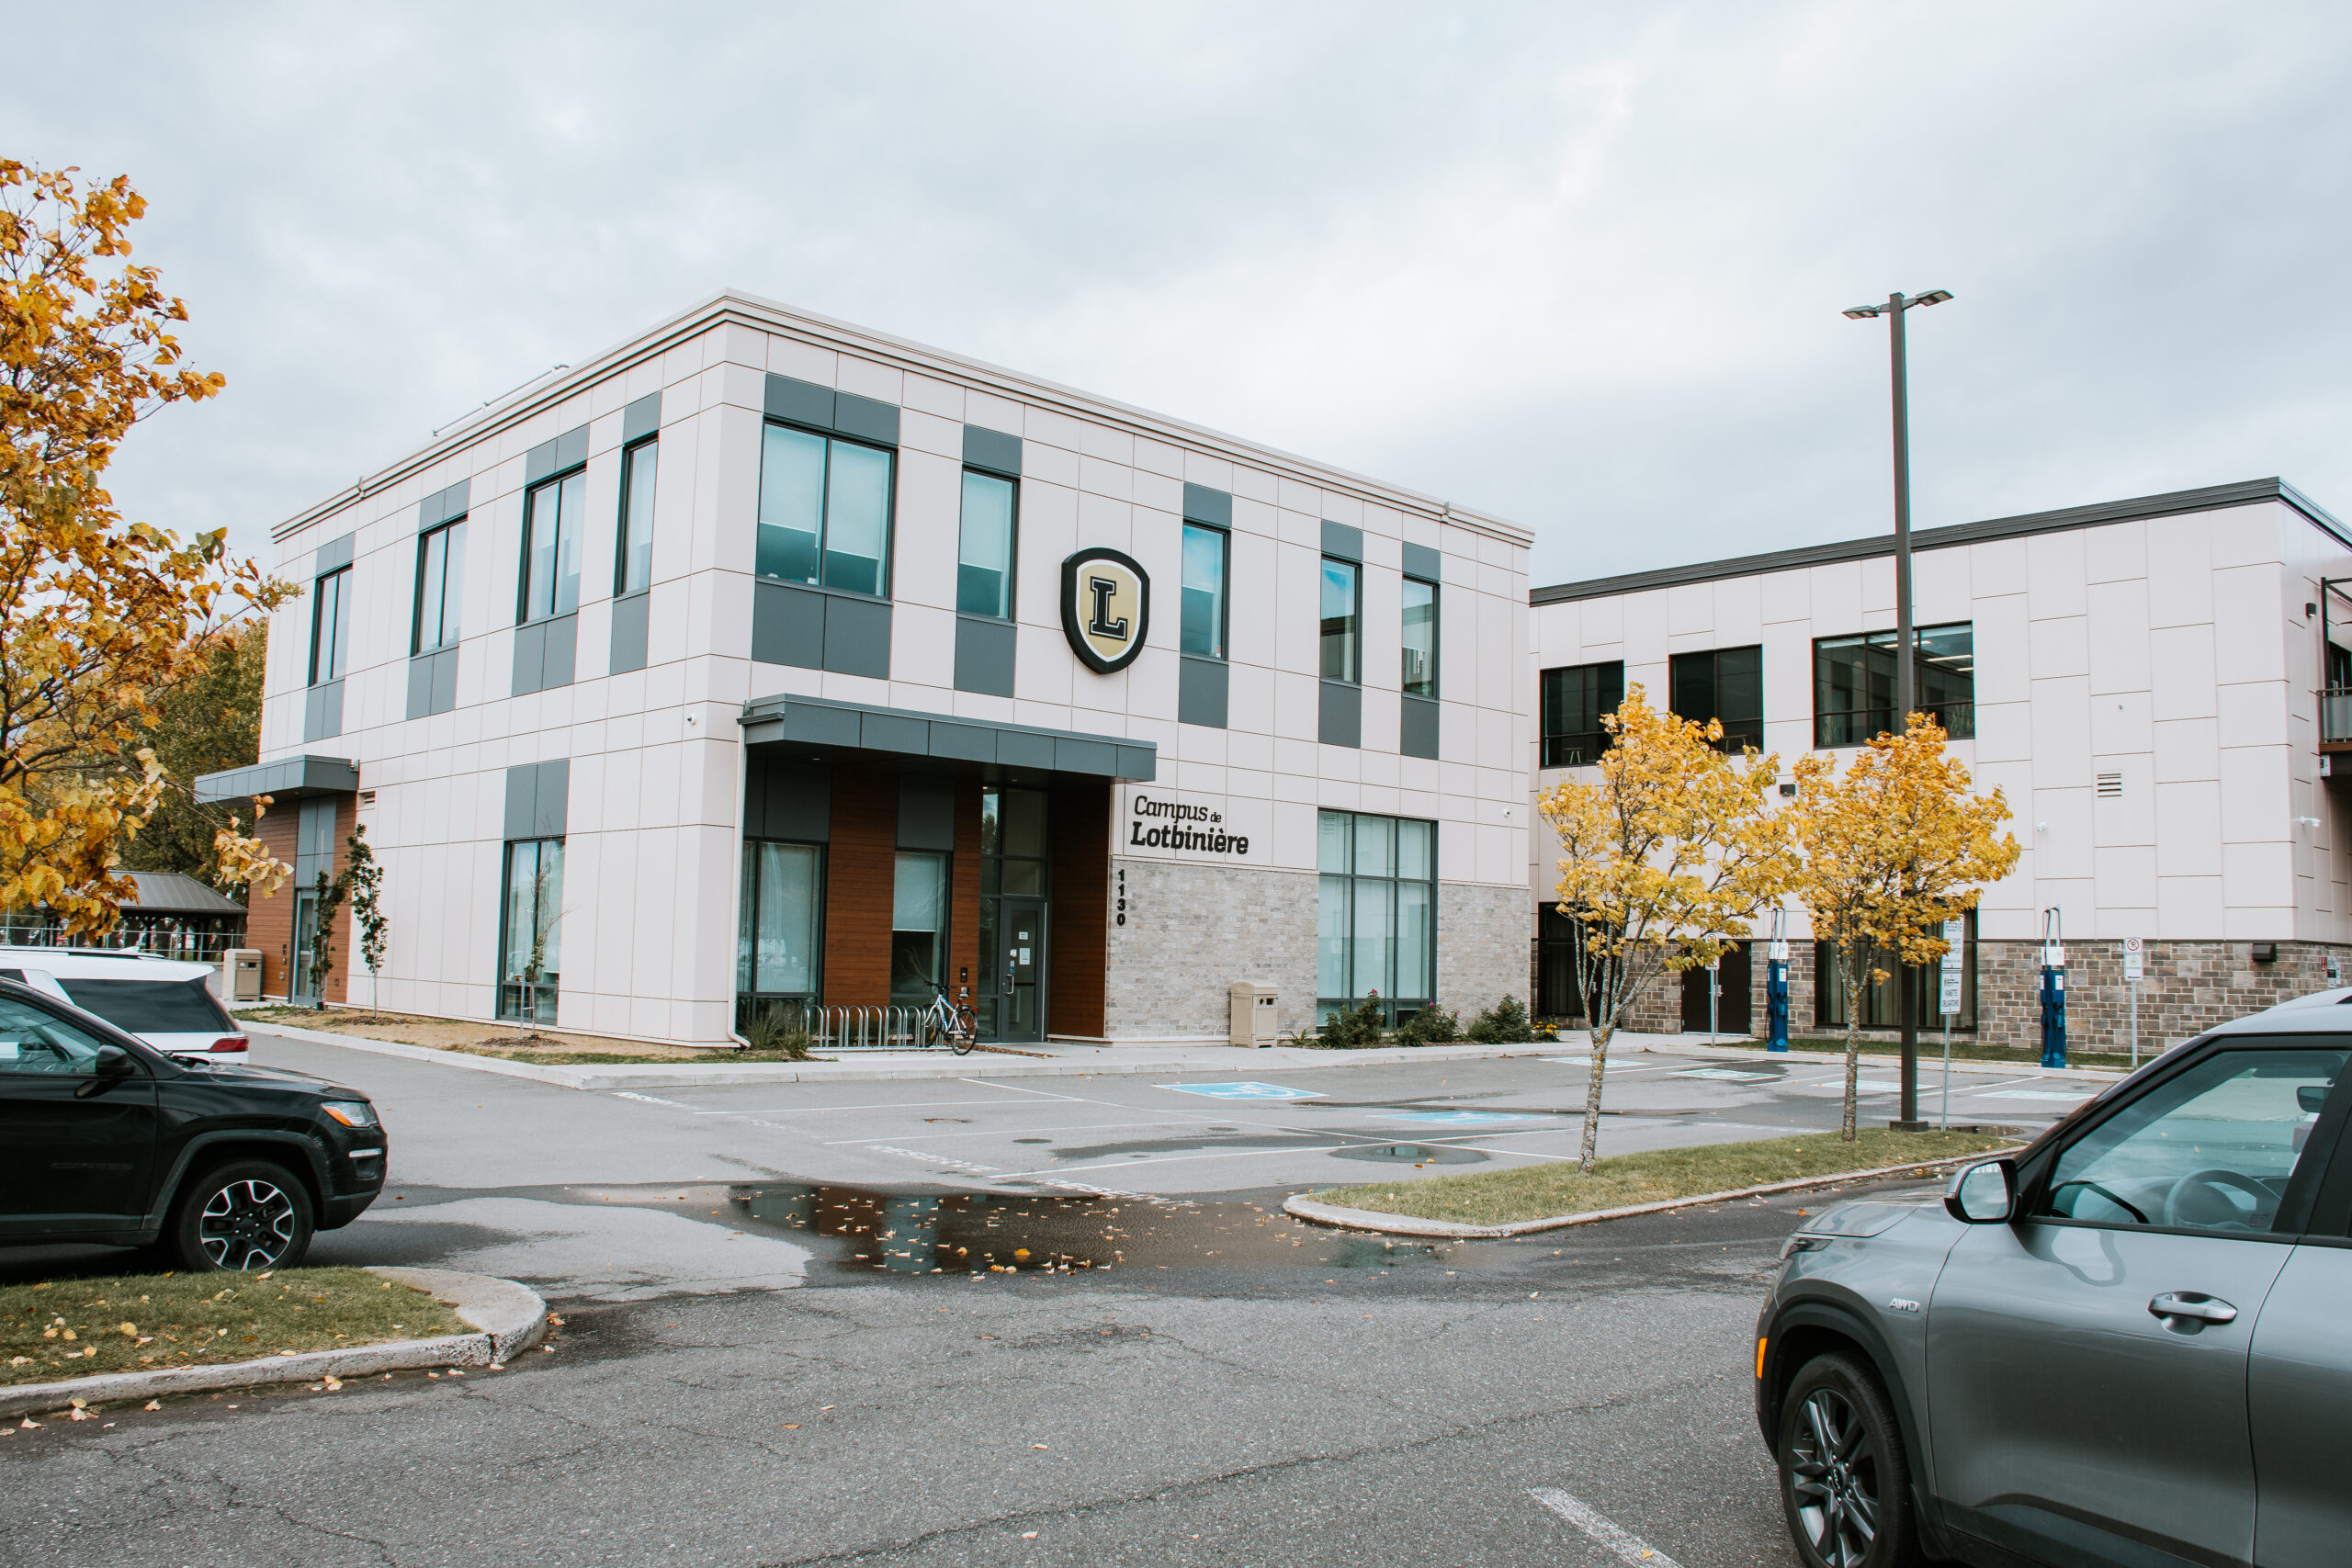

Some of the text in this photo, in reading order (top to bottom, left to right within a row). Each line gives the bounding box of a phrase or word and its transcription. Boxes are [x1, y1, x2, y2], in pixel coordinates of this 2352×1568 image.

[1089, 576, 1128, 641] L
[1134, 795, 1222, 823] Campus de
[1130, 821, 1249, 854] Lotbinière
[1116, 868, 1125, 926] 1130
[1889, 1297, 1920, 1313] AWD
